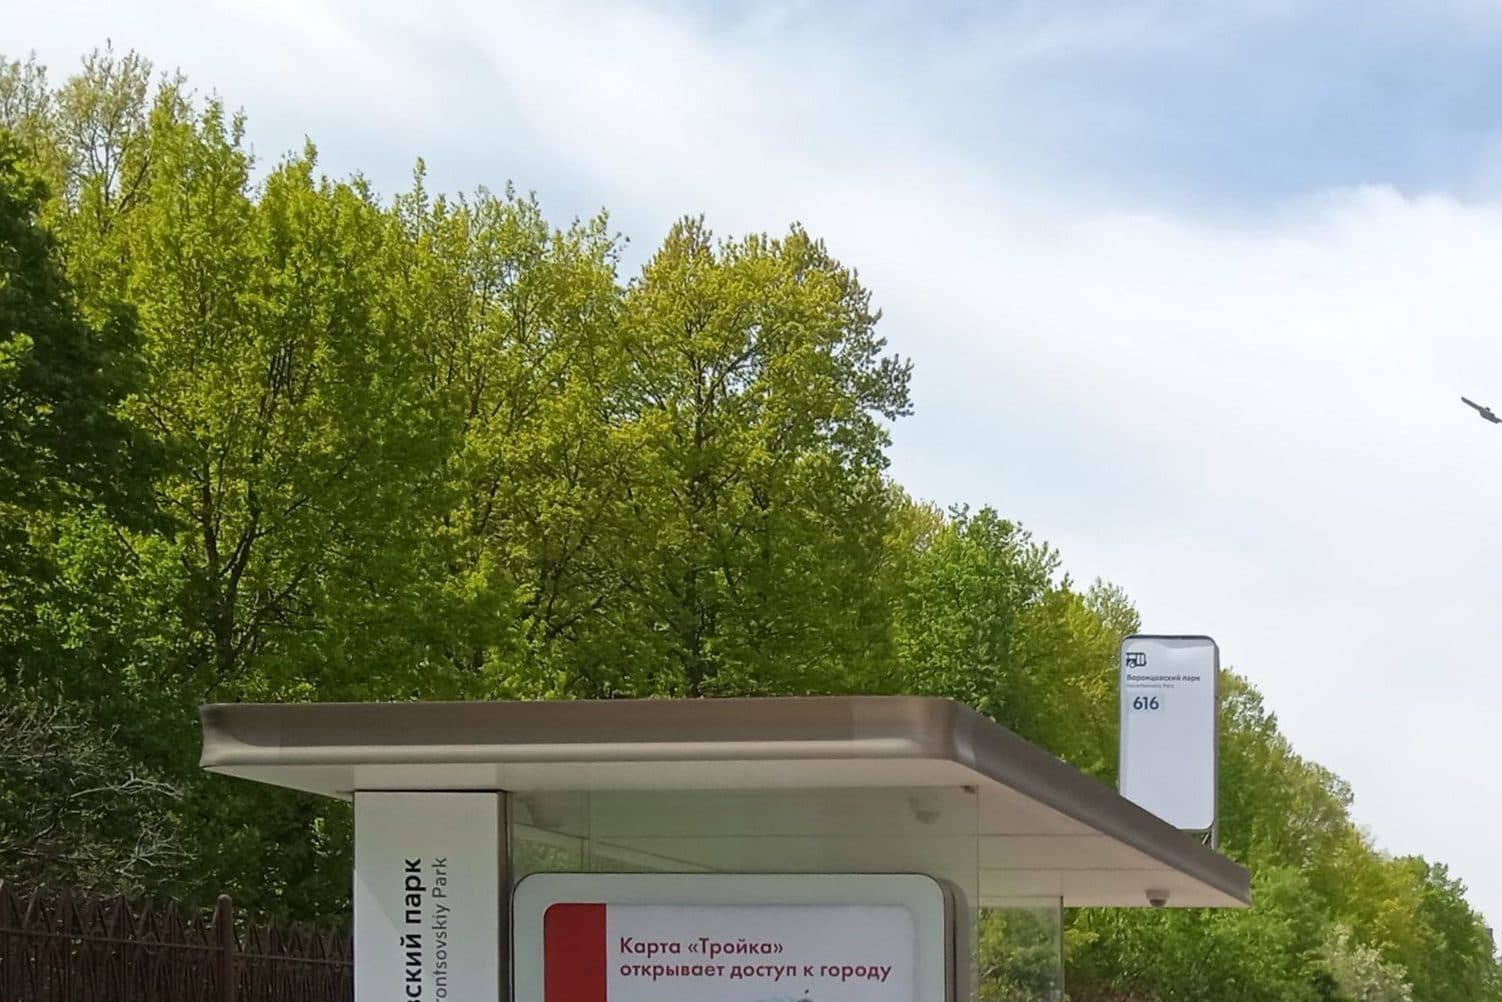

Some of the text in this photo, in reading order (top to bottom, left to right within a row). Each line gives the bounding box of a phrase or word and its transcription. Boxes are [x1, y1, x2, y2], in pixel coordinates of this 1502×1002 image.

[1133, 696, 1159, 710] 616
[431, 857, 448, 898] Park
[404, 858, 427, 924] парк
[620, 937, 783, 959] Карта «Тройка»
[620, 964, 892, 982] открывает доступ к городу
